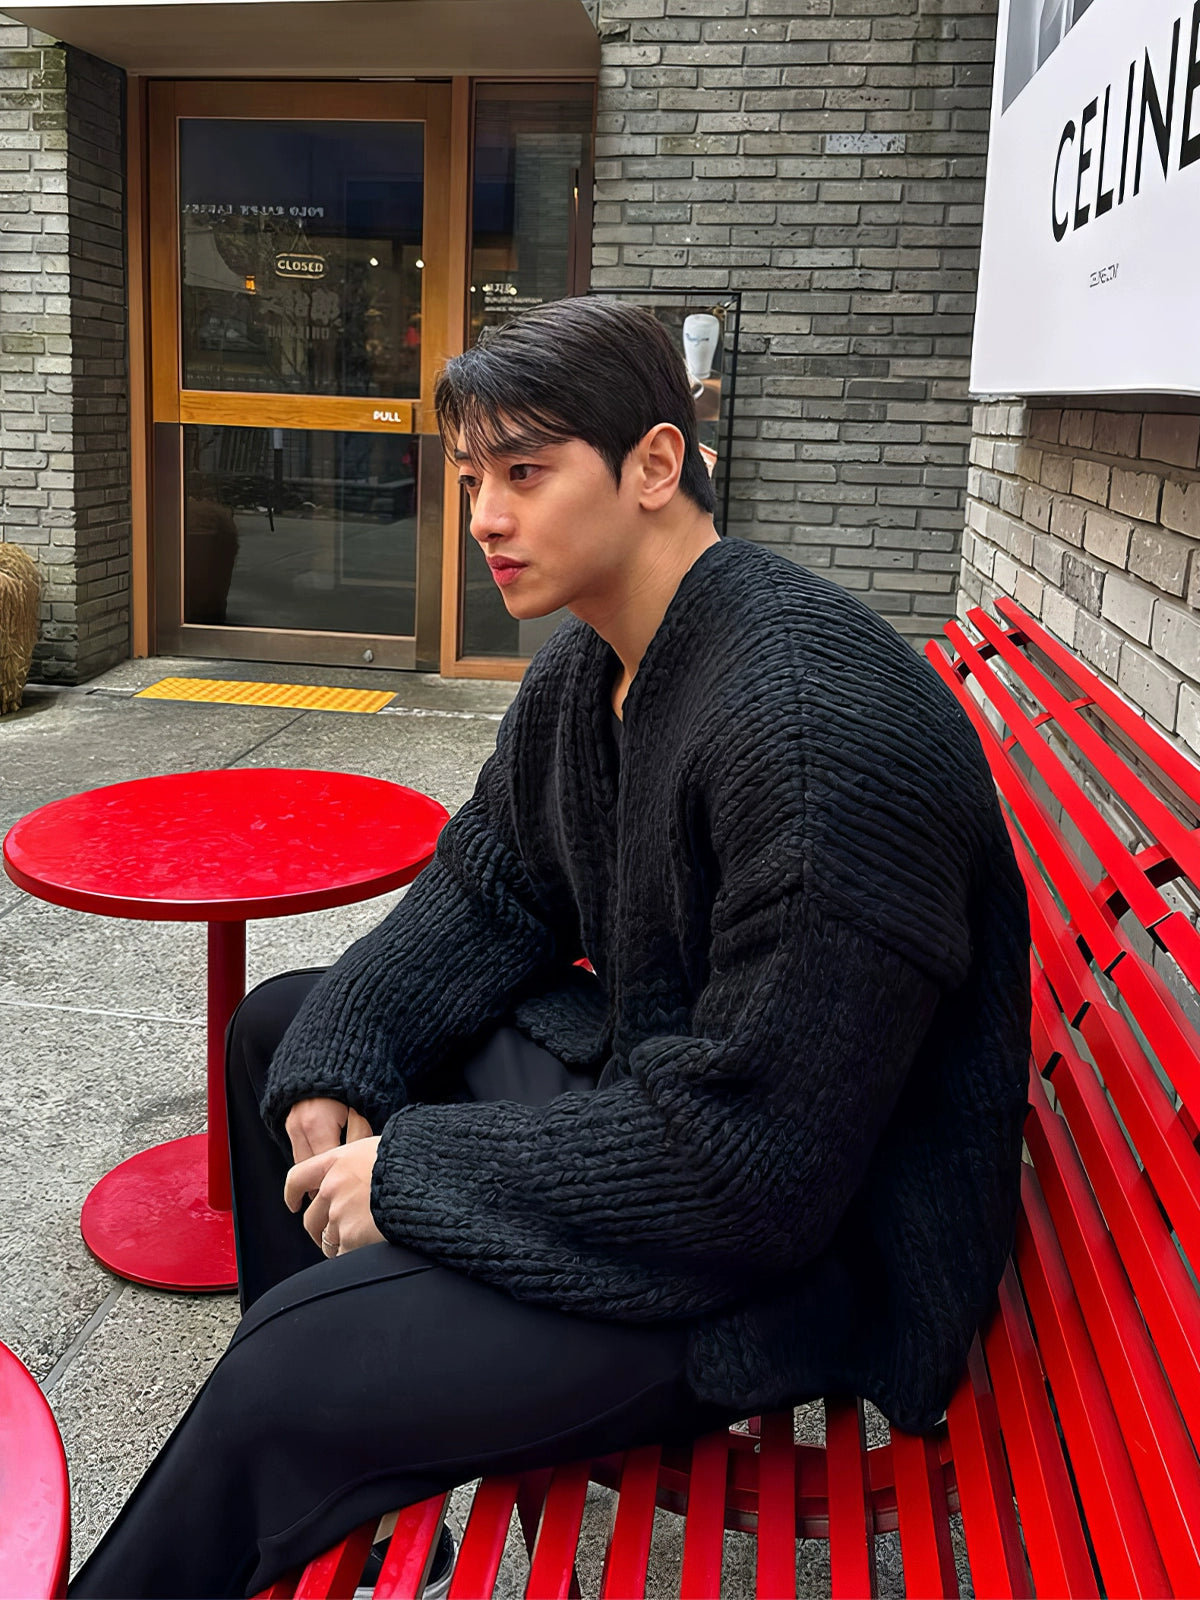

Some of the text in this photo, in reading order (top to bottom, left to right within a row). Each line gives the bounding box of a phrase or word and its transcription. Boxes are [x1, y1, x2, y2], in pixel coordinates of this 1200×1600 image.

[1052, 0, 1200, 243] CELINE
[277, 260, 324, 272] CLOSED
[373, 410, 402, 423] PULL
